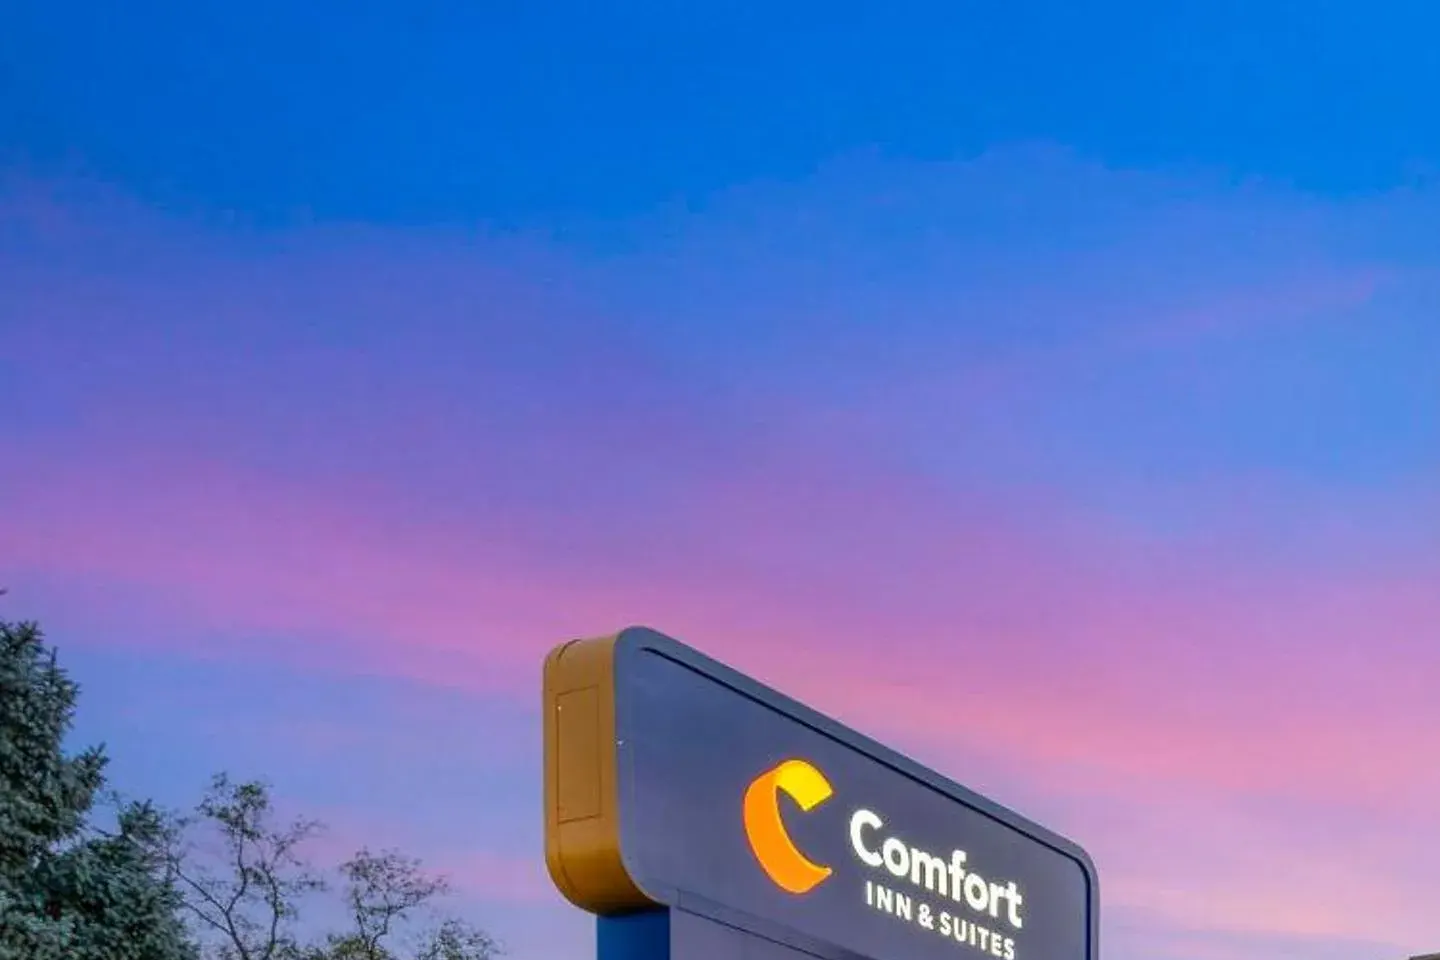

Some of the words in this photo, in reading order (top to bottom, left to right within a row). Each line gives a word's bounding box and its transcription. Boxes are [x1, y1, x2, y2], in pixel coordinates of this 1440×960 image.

[850, 809, 1023, 928] Comfort
[866, 880, 912, 921] INN
[918, 903, 935, 930] &
[939, 911, 1015, 960] SUITES
